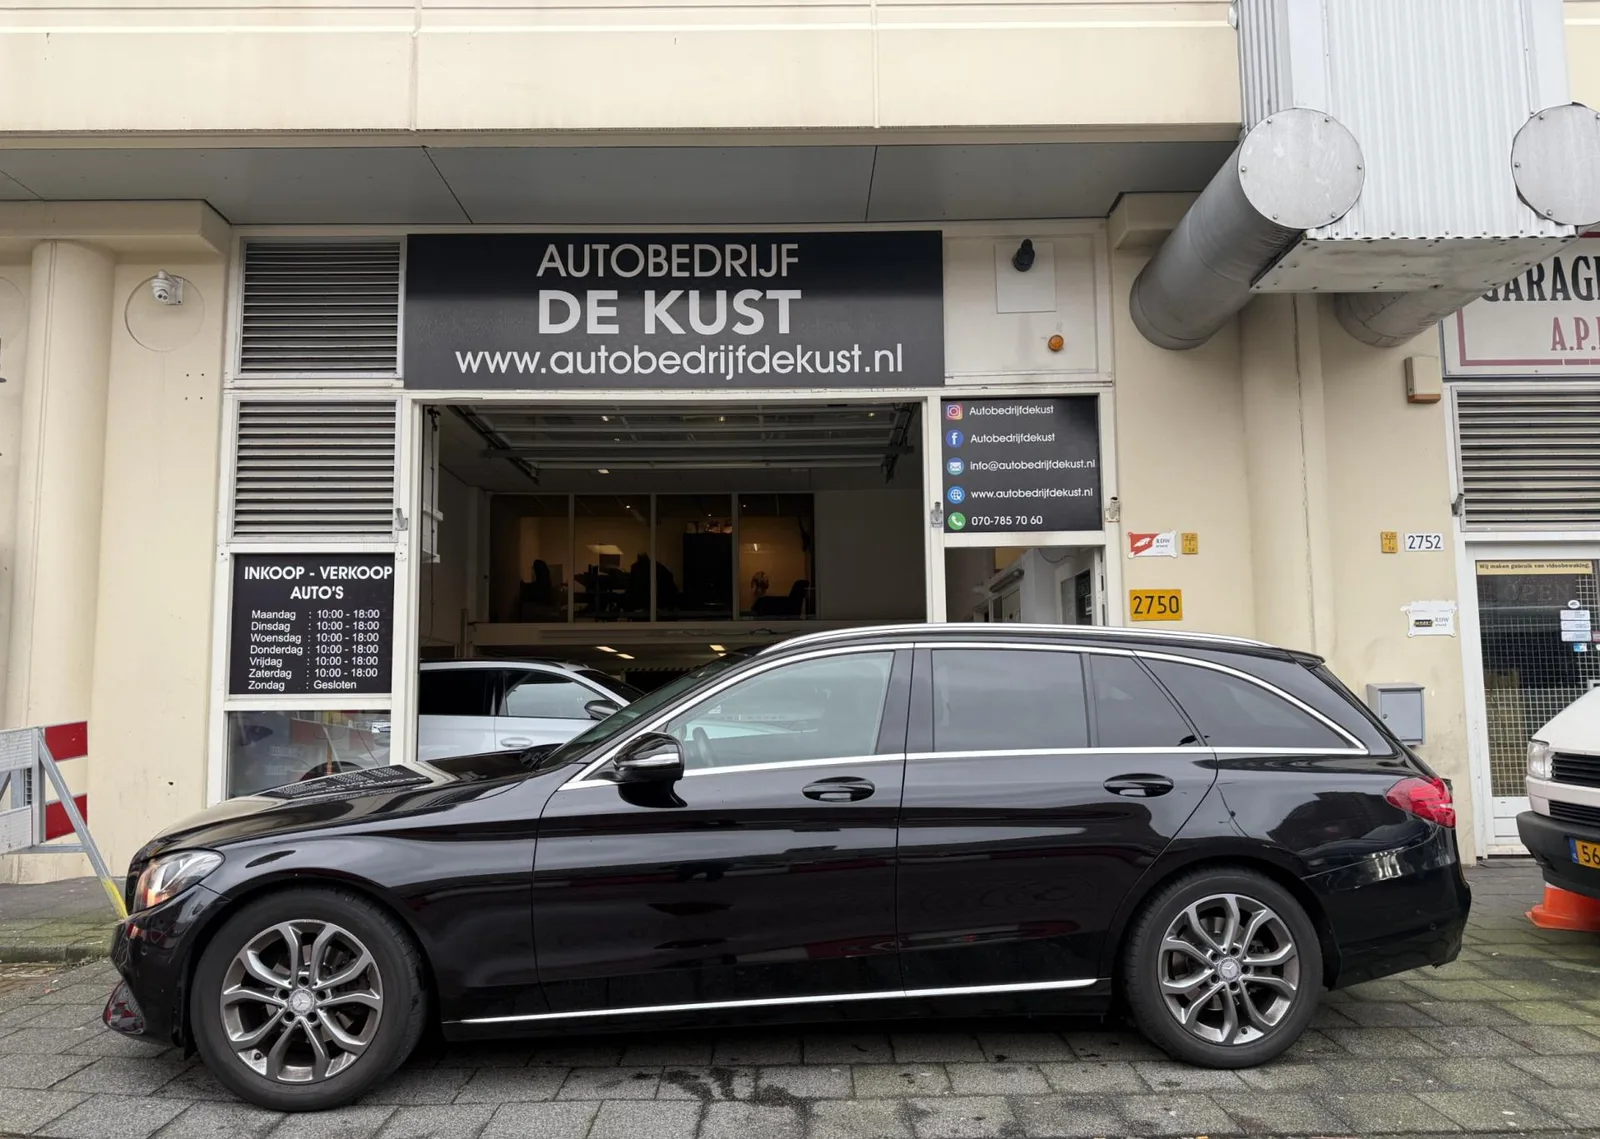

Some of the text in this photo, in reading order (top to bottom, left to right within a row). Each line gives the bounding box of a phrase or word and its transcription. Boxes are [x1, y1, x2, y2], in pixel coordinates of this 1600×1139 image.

[537, 243, 800, 278] AUTOBEDRIJF
[538, 289, 801, 335] DE KUST
[1551, 316, 1600, 351] A.P.
[455, 344, 903, 380] www.autobedrijfdekust.nl
[969, 405, 1054, 416] Autobedrijfdekust
[970, 433, 1055, 444] Autobedrijfdekust
[970, 460, 1096, 471] info@autobedrijfdekust.nl
[971, 488, 1093, 498] www.autobedrijfdekust.nl
[972, 516, 1043, 526] 070-785 70 60
[1408, 535, 1441, 549] 2752
[244, 566, 304, 580] INKOOP
[320, 566, 392, 579] VERKOOP
[290, 586, 344, 599] AUTO'S
[1133, 595, 1179, 614] 2750
[251, 610, 296, 620] Maandag
[317, 610, 343, 618] 10:00
[353, 610, 380, 618] 18:00
[251, 622, 290, 632] Dinsdag
[316, 621, 343, 630] 10:00
[353, 621, 379, 630] 18:00
[250, 634, 302, 644] Woensdag
[316, 633, 342, 642] 10:00
[352, 633, 379, 642] 18:00
[250, 645, 303, 656] Donderdag
[315, 645, 342, 654] 10:00
[352, 645, 379, 654] 18:00
[249, 657, 282, 667] Vrijdag
[315, 657, 341, 666] 10:00
[352, 657, 378, 666] 18:00
[249, 669, 292, 679] Zaterdag
[314, 668, 341, 677] 10:00
[351, 668, 378, 677] 18:00
[248, 681, 285, 691] Zondag
[314, 680, 356, 689] Gesloten
